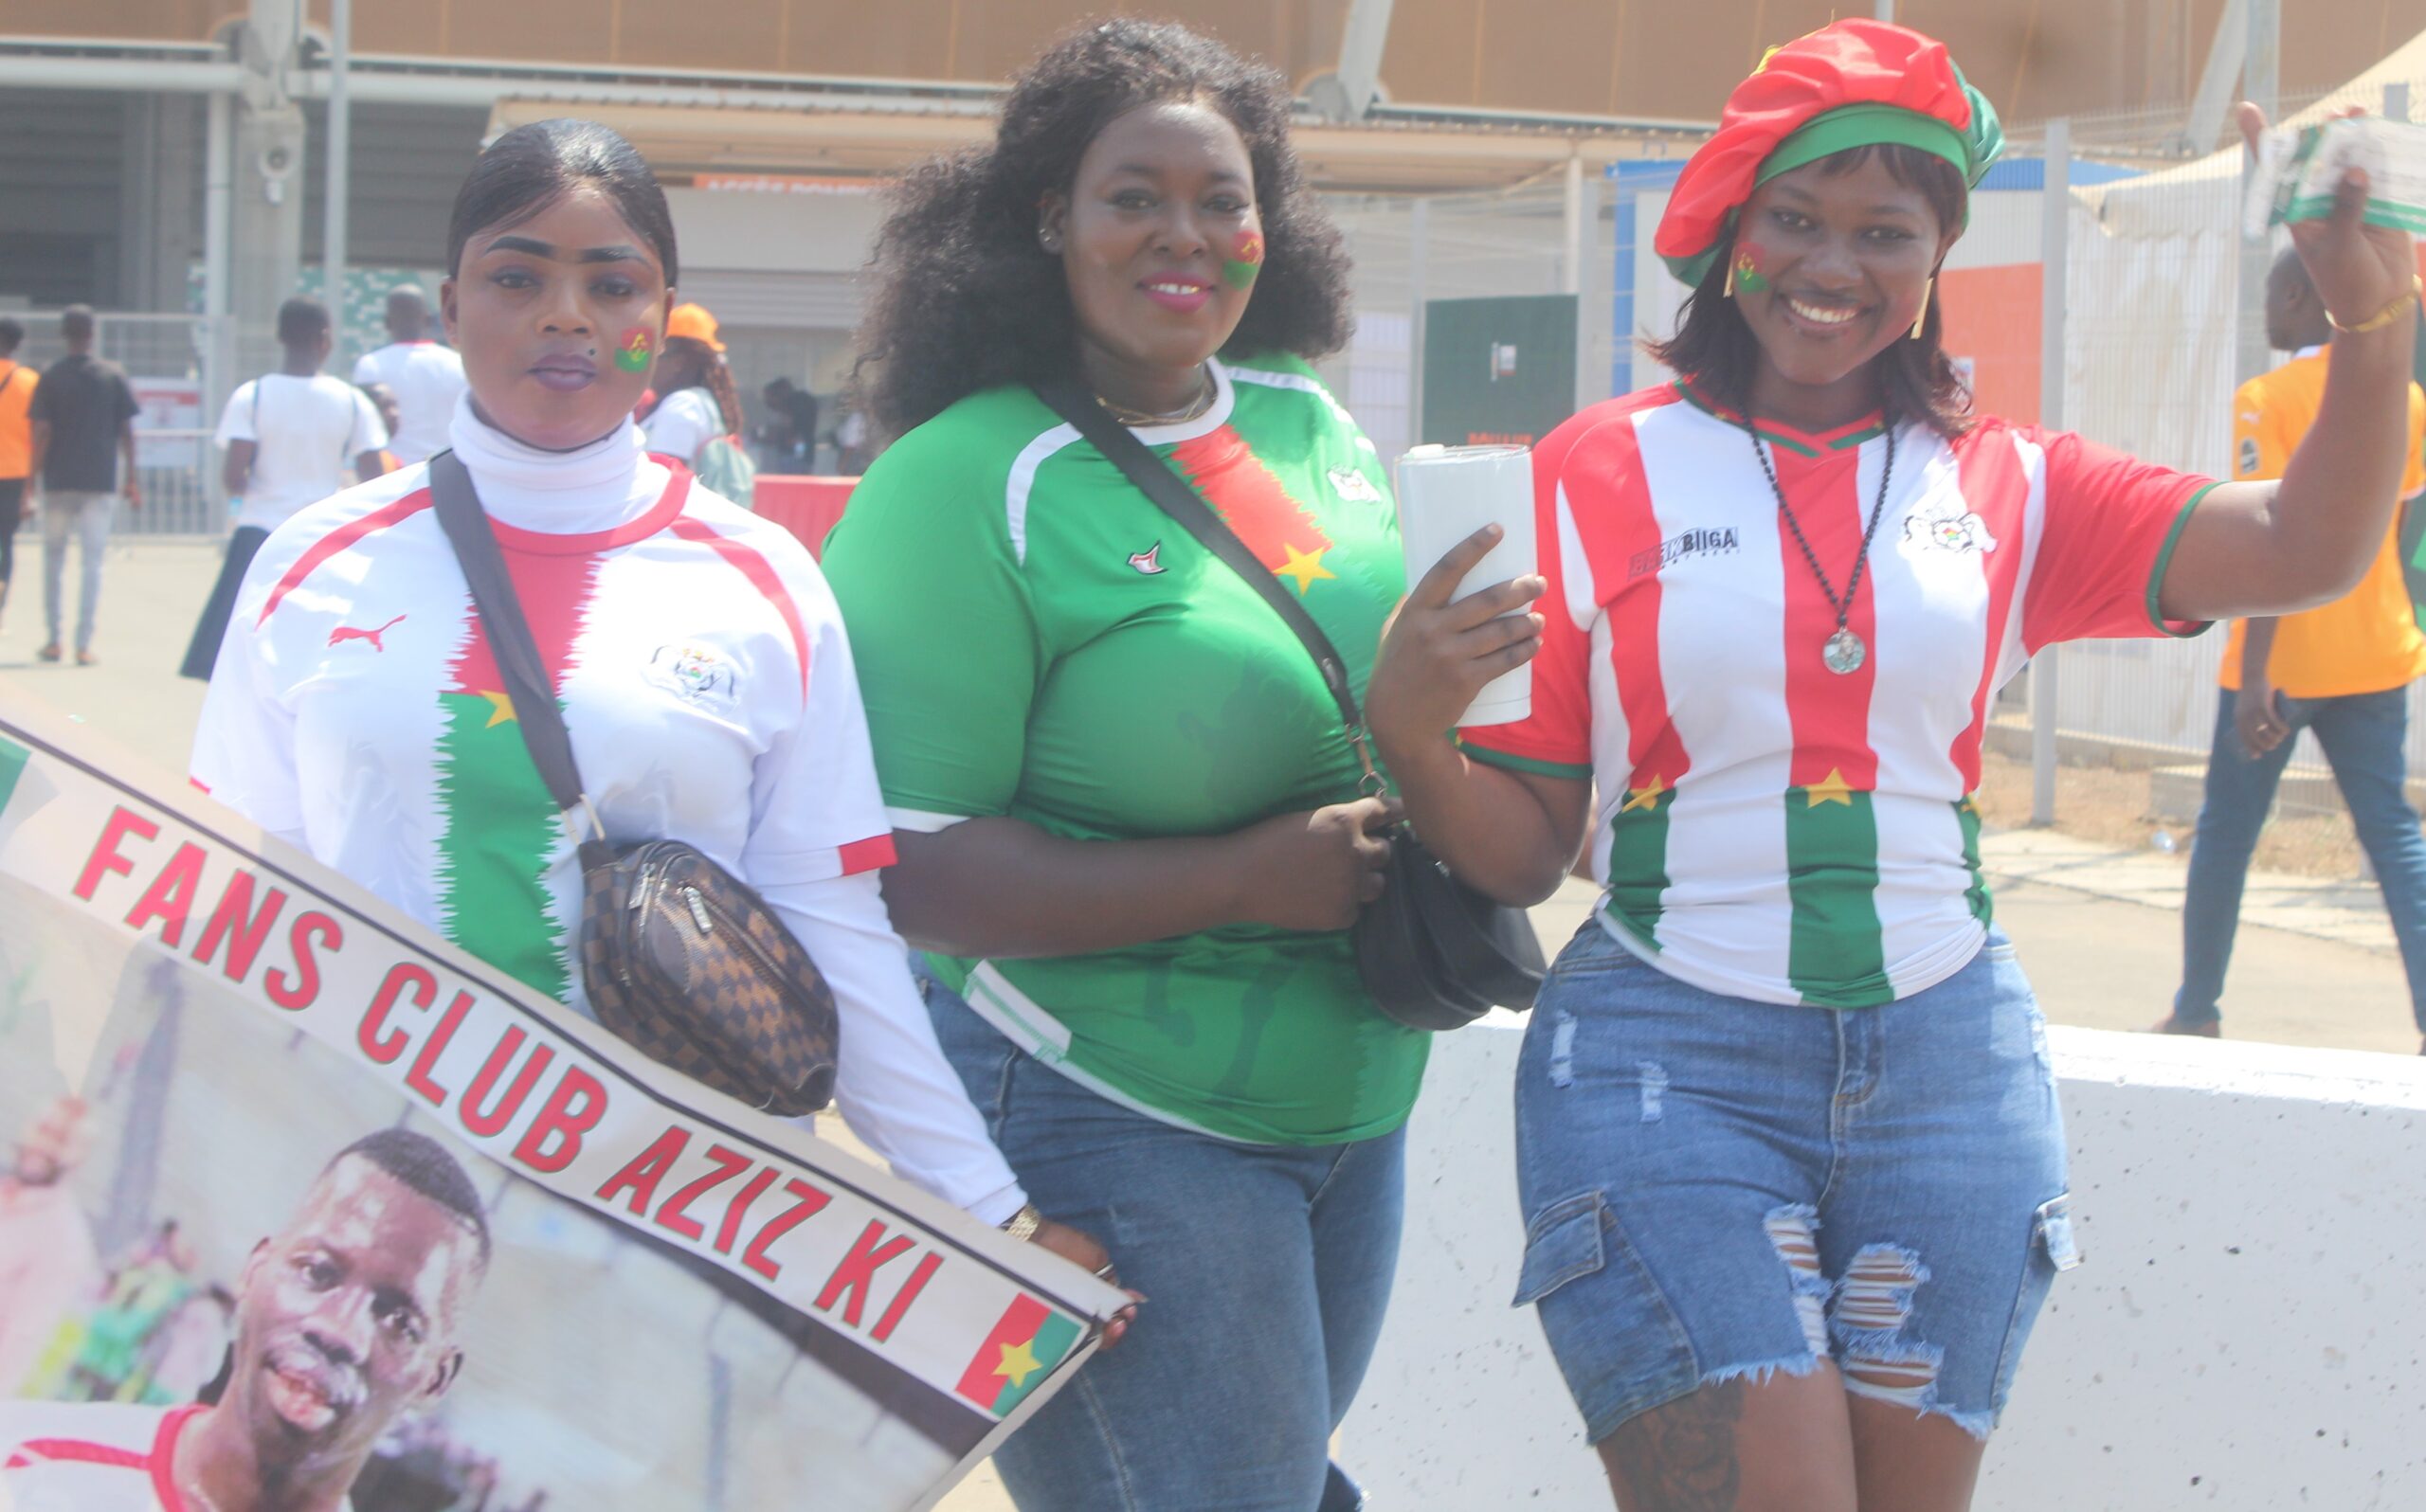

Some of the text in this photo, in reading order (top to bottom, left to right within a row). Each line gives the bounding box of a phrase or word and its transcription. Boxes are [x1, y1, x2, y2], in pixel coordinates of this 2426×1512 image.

[72, 804, 945, 1343] FANS CLUB AZIZ KI
